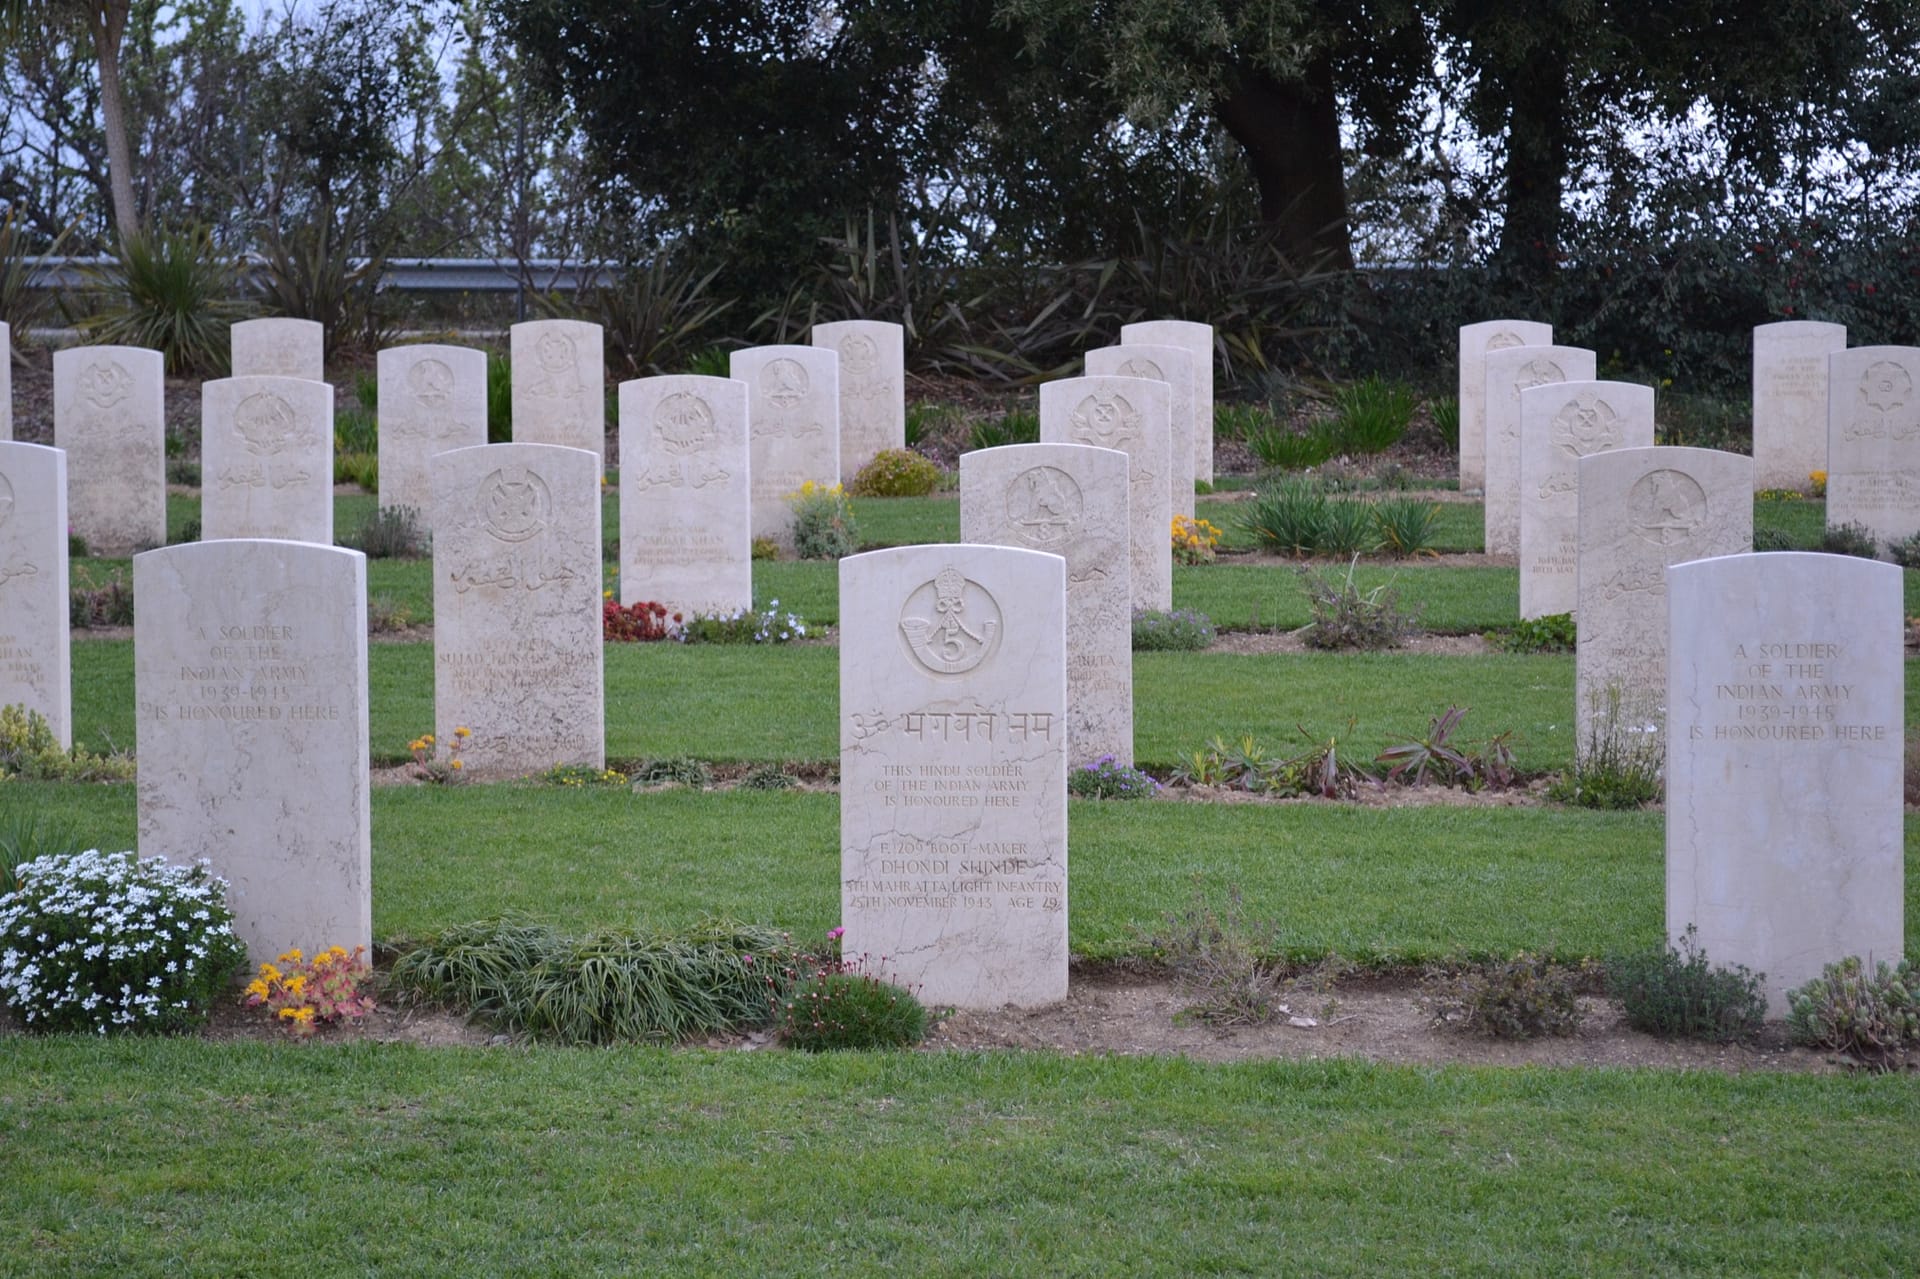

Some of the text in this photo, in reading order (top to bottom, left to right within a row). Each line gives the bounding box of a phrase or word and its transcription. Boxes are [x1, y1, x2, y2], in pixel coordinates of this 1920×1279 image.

[196, 626, 294, 641] A SOLDIER
[209, 646, 282, 660] OF THE
[1734, 644, 1840, 659] A SOLDIER
[180, 666, 308, 681] INDIAN ARMY
[1748, 664, 1824, 679] OF THE
[1715, 684, 1856, 699] INDIAN ARMY
[154, 706, 339, 721] IS HONOURED HERE
[1738, 705, 1835, 722] 1939-1945
[1689, 725, 1886, 740] IS HONOURED HERE
[882, 765, 1024, 777] THIS HINDU SOLDIER
[874, 780, 1030, 792] OF THE INDIAN ARMY
[884, 795, 1020, 807] IS HONOURED HERE
[881, 859, 1028, 875] DHONDI SHINDE
[872, 880, 947, 893] MAHRATTA
[952, 880, 993, 893] LIGHT
[997, 881, 1062, 893] INFANTRY
[849, 895, 881, 908] 25TH
[887, 895, 958, 908] NOVEMBER
[963, 895, 993, 909] 1943
[1007, 896, 1034, 908] AGE
